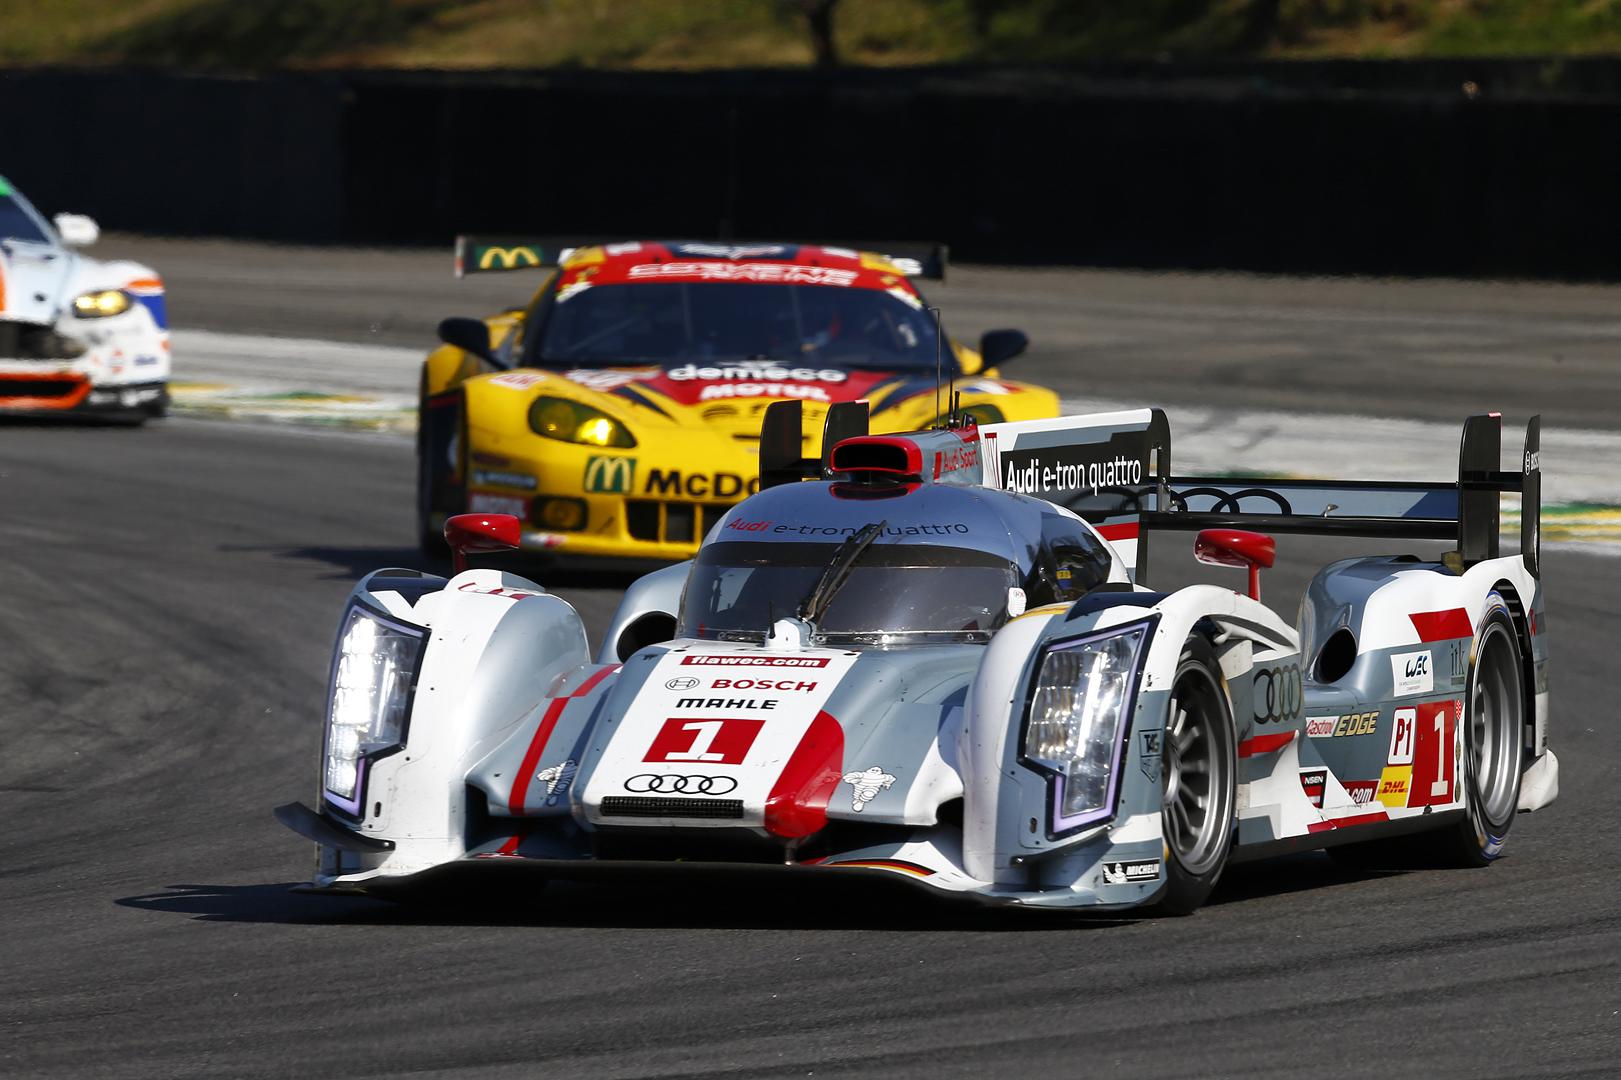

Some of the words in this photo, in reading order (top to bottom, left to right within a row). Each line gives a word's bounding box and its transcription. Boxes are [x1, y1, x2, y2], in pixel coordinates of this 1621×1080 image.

[701, 382, 831, 400] MOTUL
[1006, 459, 1039, 493] Audi
[1043, 460, 1085, 493] e-tron
[1089, 456, 1141, 496] quattro
[726, 518, 773, 532] Audi
[774, 523, 856, 536] e-tron
[1406, 655, 1428, 677] WEC
[711, 679, 818, 692] BOSCH
[676, 698, 779, 710] MAHLE
[1307, 719, 1336, 735] Castrol
[1334, 711, 1379, 737] EDGE
[664, 720, 725, 761] 1
[1393, 718, 1412, 756] P1
[1430, 710, 1449, 797] 1
[1302, 775, 1324, 785] NSEN
[1381, 780, 1405, 794] DHL
